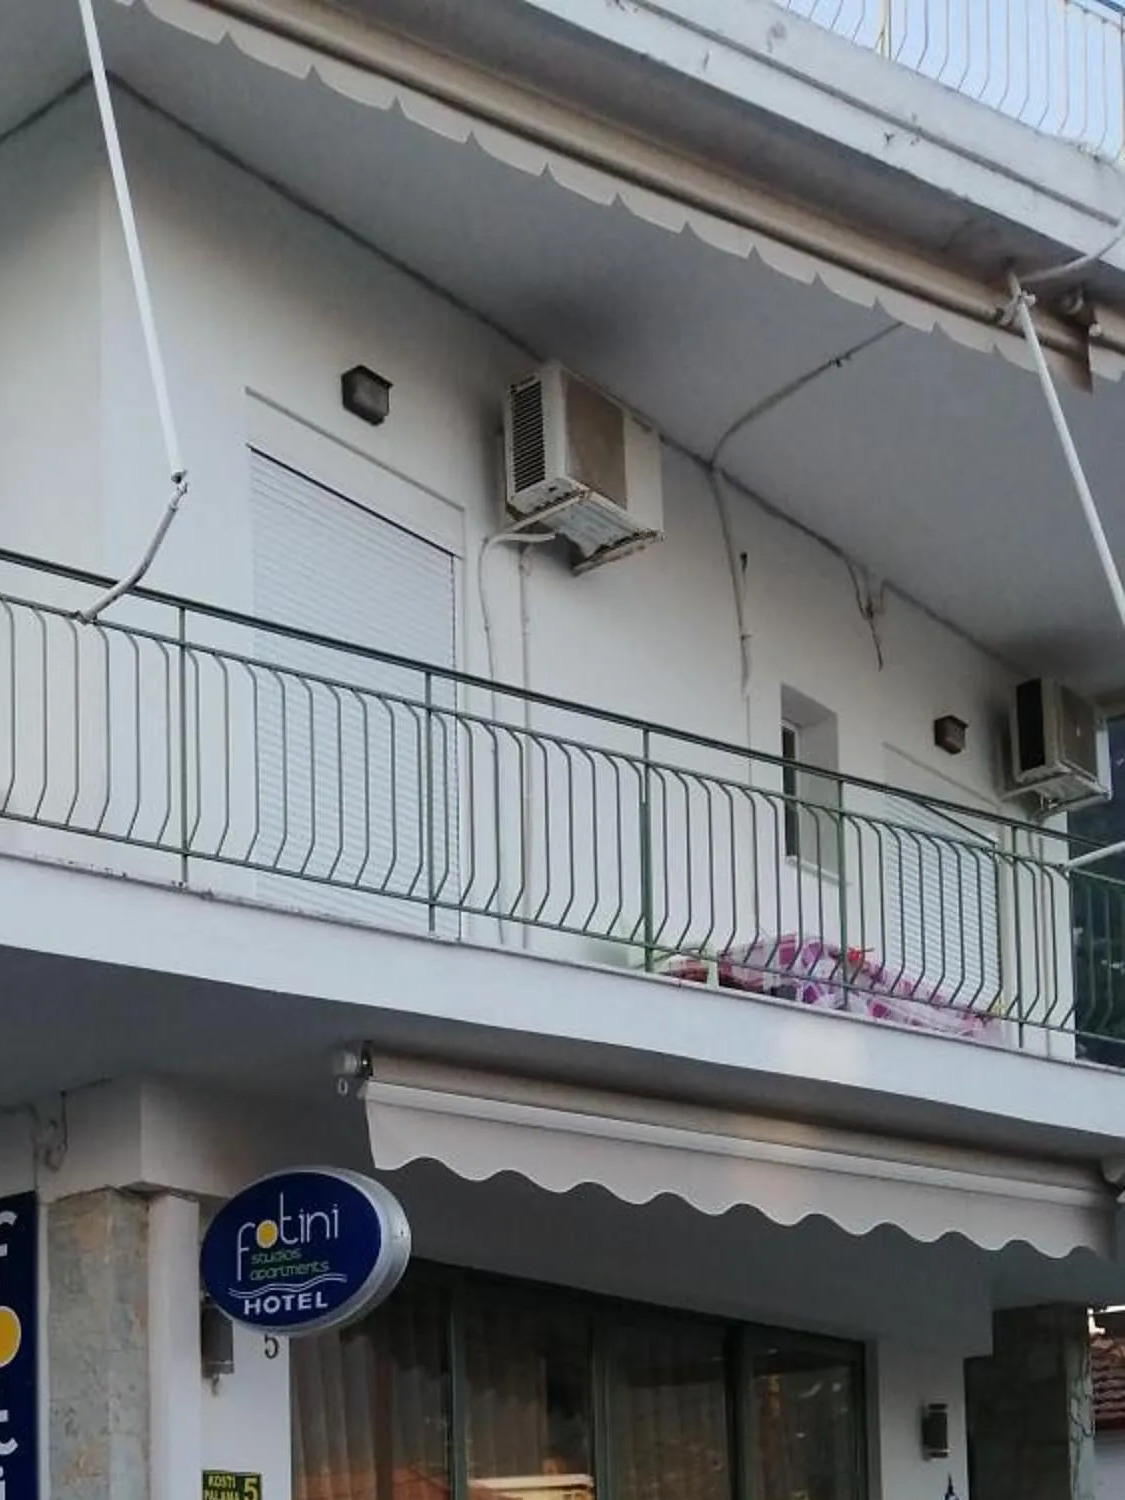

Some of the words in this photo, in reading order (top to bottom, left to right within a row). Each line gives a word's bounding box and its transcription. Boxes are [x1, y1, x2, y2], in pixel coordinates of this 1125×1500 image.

[236, 1191, 340, 1281] fotini
[250, 1248, 302, 1265] studios
[249, 1260, 331, 1282] apartments
[243, 1290, 329, 1316] HOTEL
